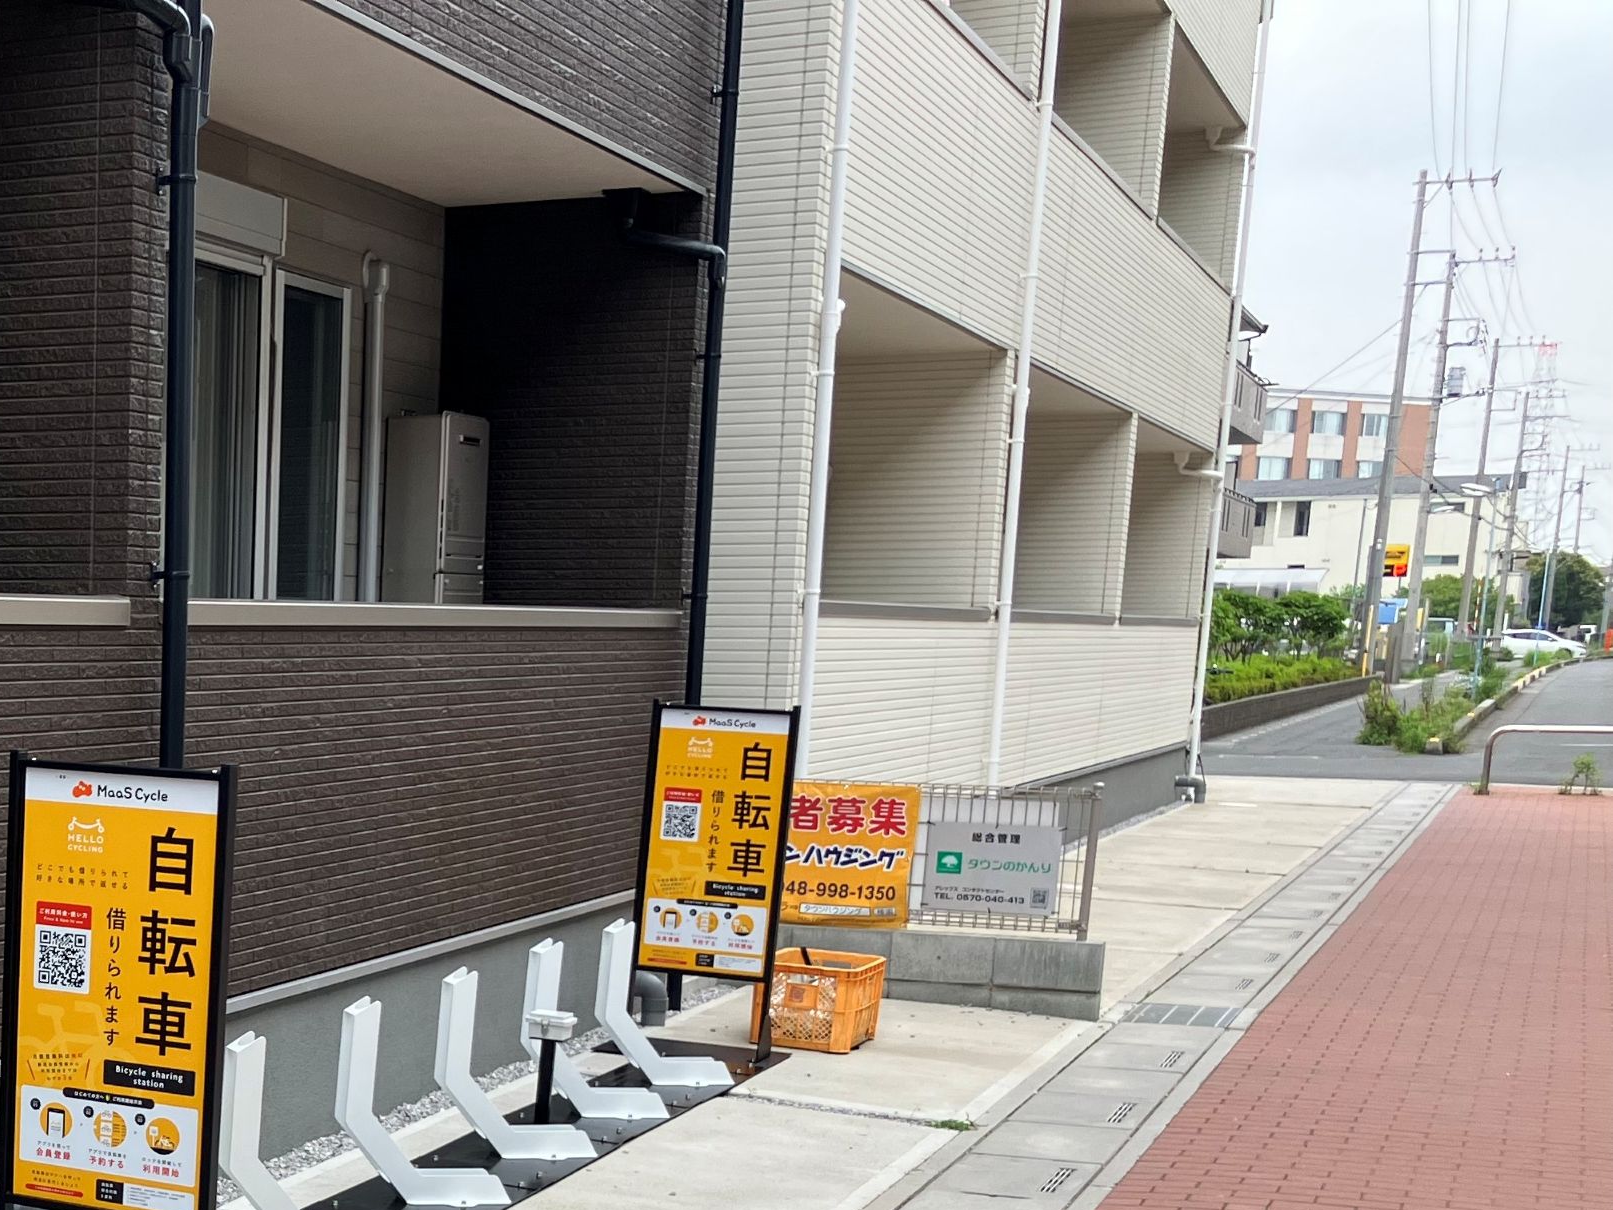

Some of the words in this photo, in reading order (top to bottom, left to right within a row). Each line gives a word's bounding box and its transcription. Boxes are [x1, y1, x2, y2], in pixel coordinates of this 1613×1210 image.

[708, 718, 733, 727] MaaS
[734, 719, 756, 729] Cycle
[96, 784, 133, 800] MaaS
[134, 787, 169, 804] Cycle
[727, 742, 772, 877] 自転車
[790, 795, 907, 837] 者募集
[67, 832, 104, 845] HELLO
[706, 790, 725, 873] 借りられます
[971, 832, 1021, 845] 総合管理
[67, 844, 104, 855] CYCLING
[967, 858, 1052, 874] タウンのかんり
[783, 880, 896, 901] 48-998-1350
[135, 827, 197, 1057] 自転車
[104, 907, 127, 1047] 借りられます
[115, 1064, 147, 1078] Bicycle
[151, 1068, 184, 1084] sharing
[132, 1077, 165, 1089] station
[36, 1147, 71, 1161] 会員登録
[88, 1155, 125, 1169] 予約する
[142, 1164, 180, 1178] 利用開始
